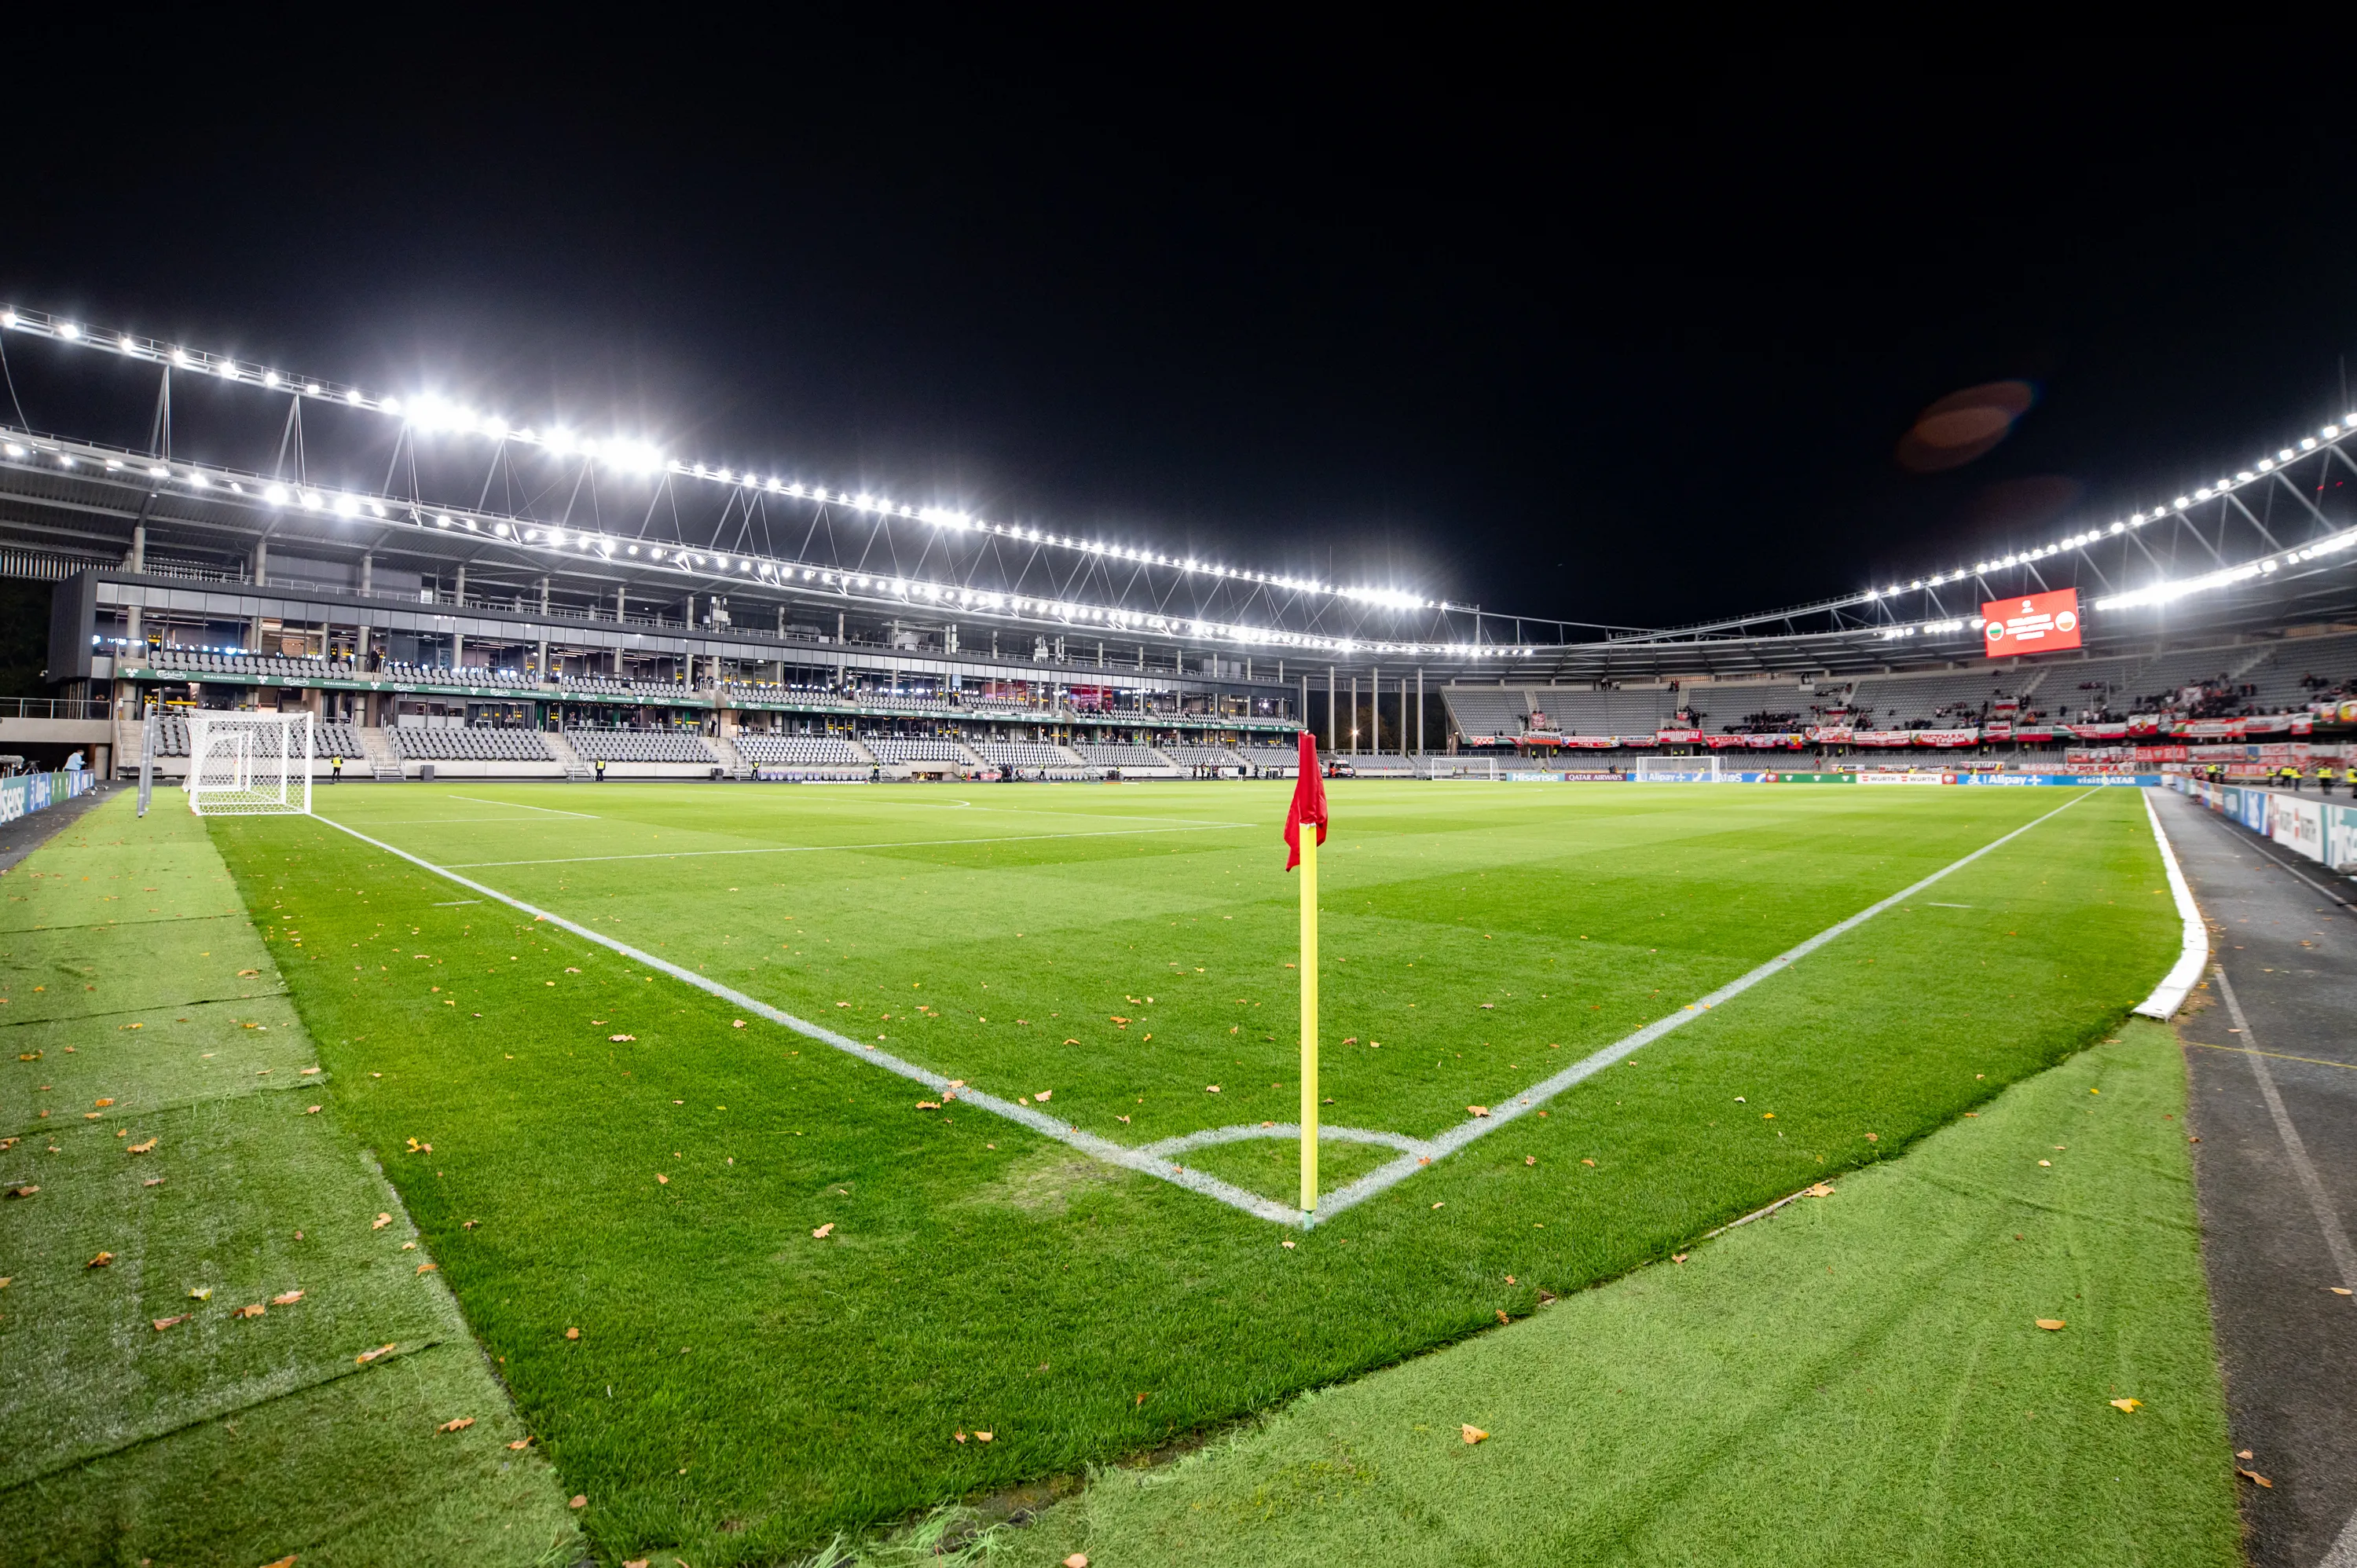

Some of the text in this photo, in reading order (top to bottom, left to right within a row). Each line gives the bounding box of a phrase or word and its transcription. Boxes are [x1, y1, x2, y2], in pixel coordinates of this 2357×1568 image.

[156, 670, 186, 680] Carlsberg
[284, 677, 310, 686] Carlsberg
[393, 683, 416, 691] Carlsberg
[1512, 773, 1558, 782] Hisense
